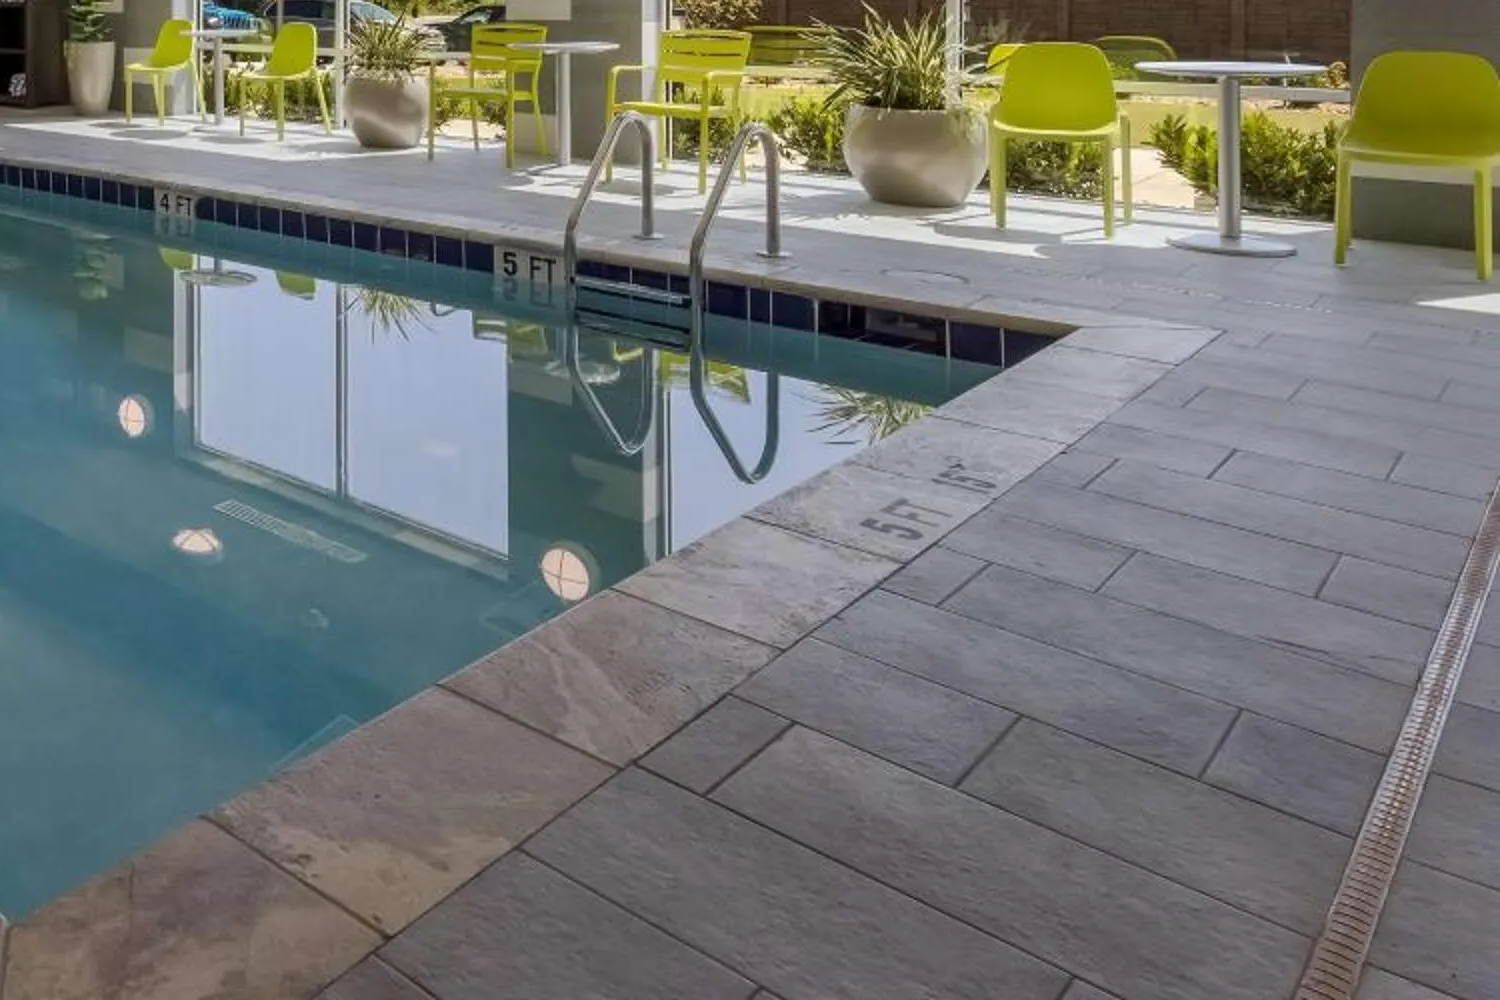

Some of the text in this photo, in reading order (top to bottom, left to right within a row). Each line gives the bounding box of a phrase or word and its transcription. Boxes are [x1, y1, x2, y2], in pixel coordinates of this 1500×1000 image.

[160, 193, 192, 217] 4 FT
[503, 251, 557, 283] 5 FT
[858, 498, 953, 541] 5 FT
